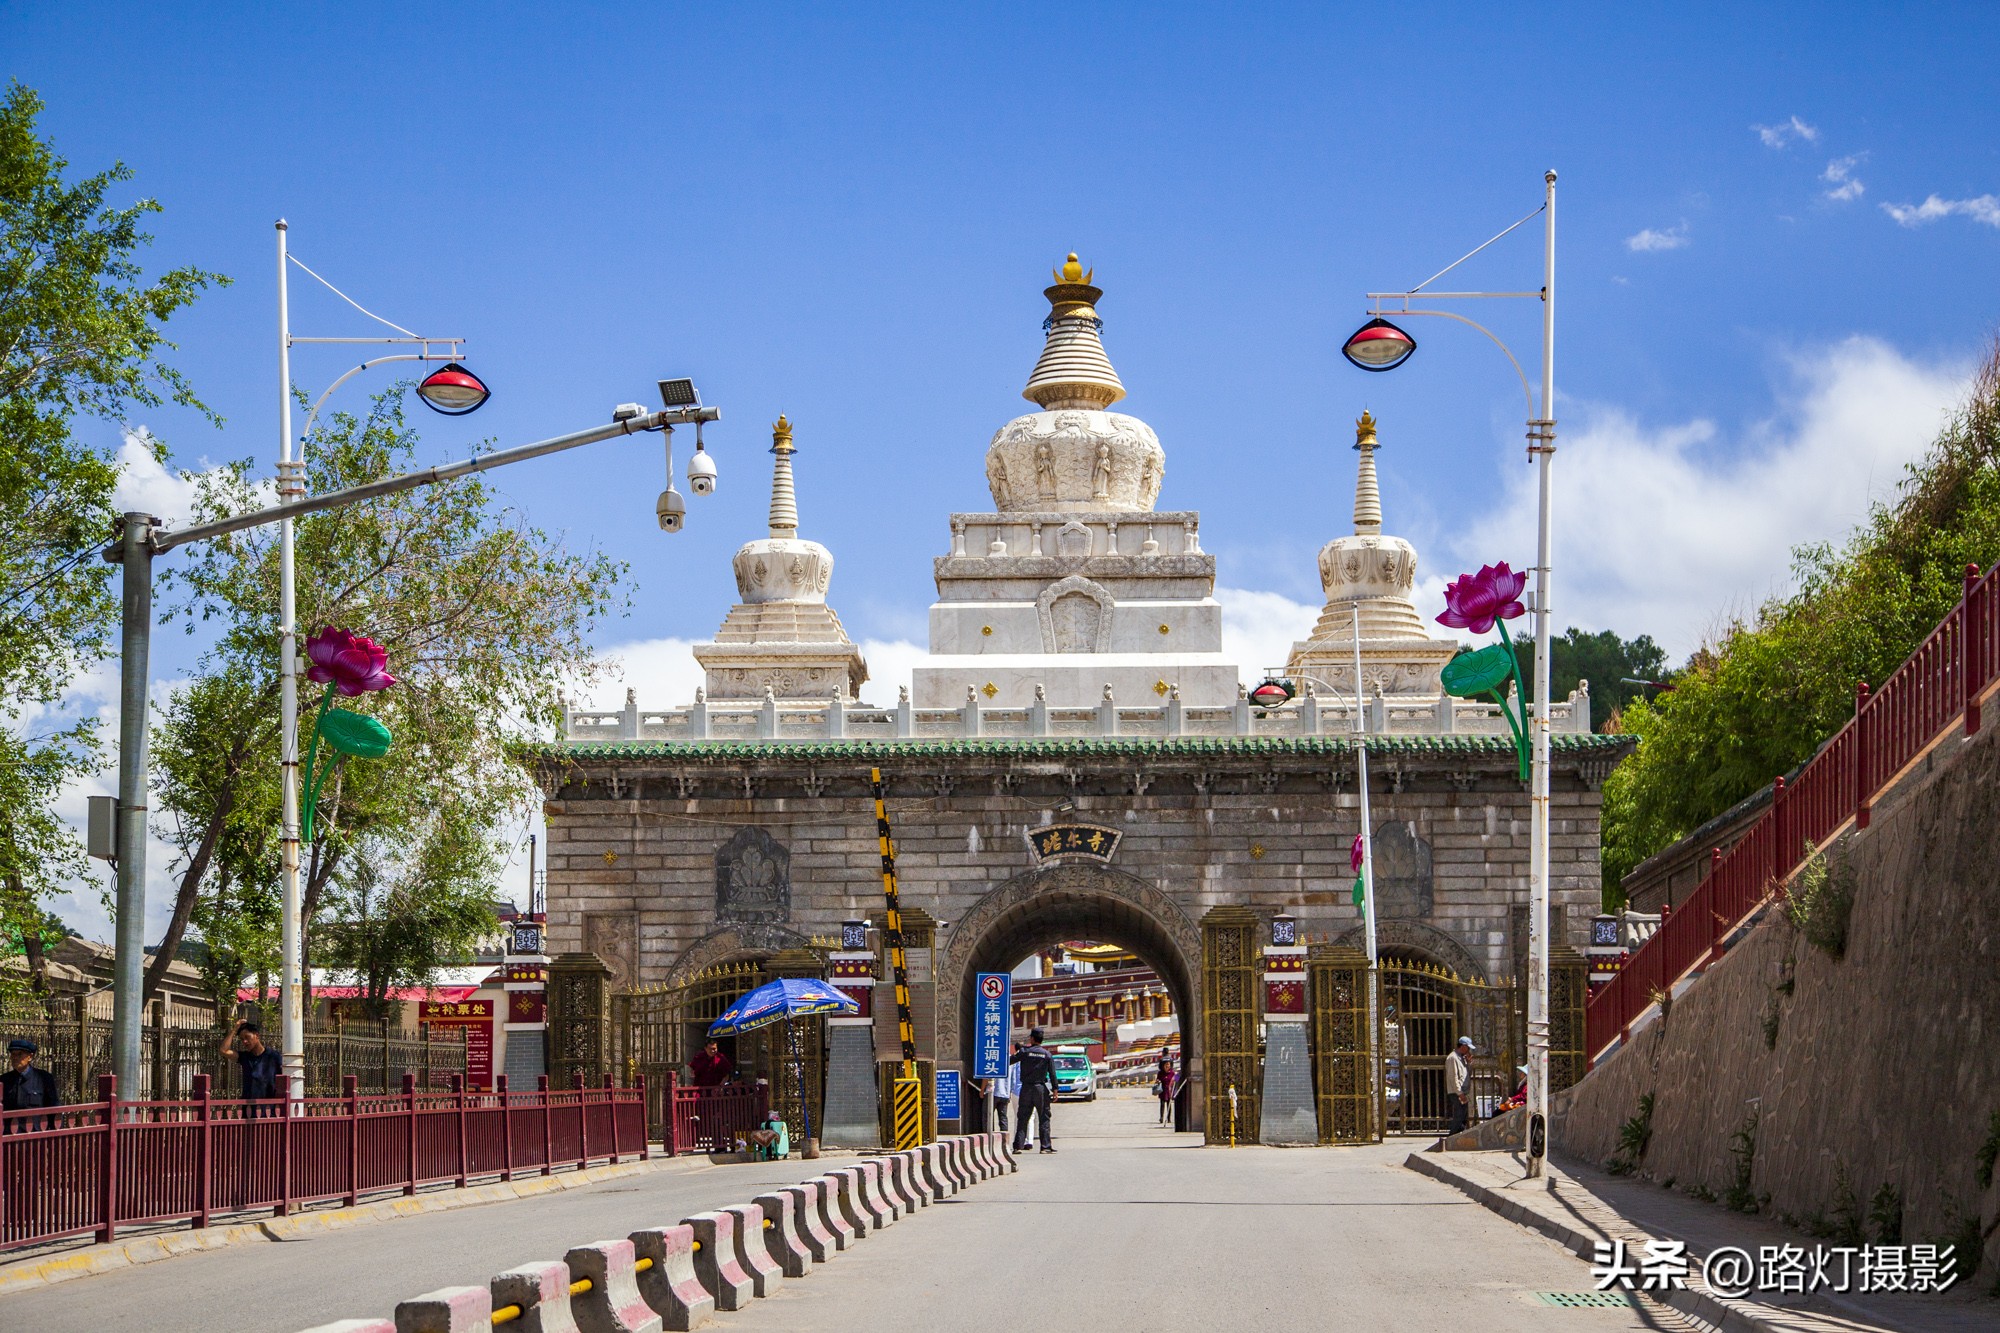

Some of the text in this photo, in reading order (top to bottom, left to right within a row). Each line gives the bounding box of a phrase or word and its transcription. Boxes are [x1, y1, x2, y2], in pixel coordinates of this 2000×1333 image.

[1043, 831, 1105, 854] 塔尔寺
[984, 1000, 1000, 1074] 车辆禁止调头
